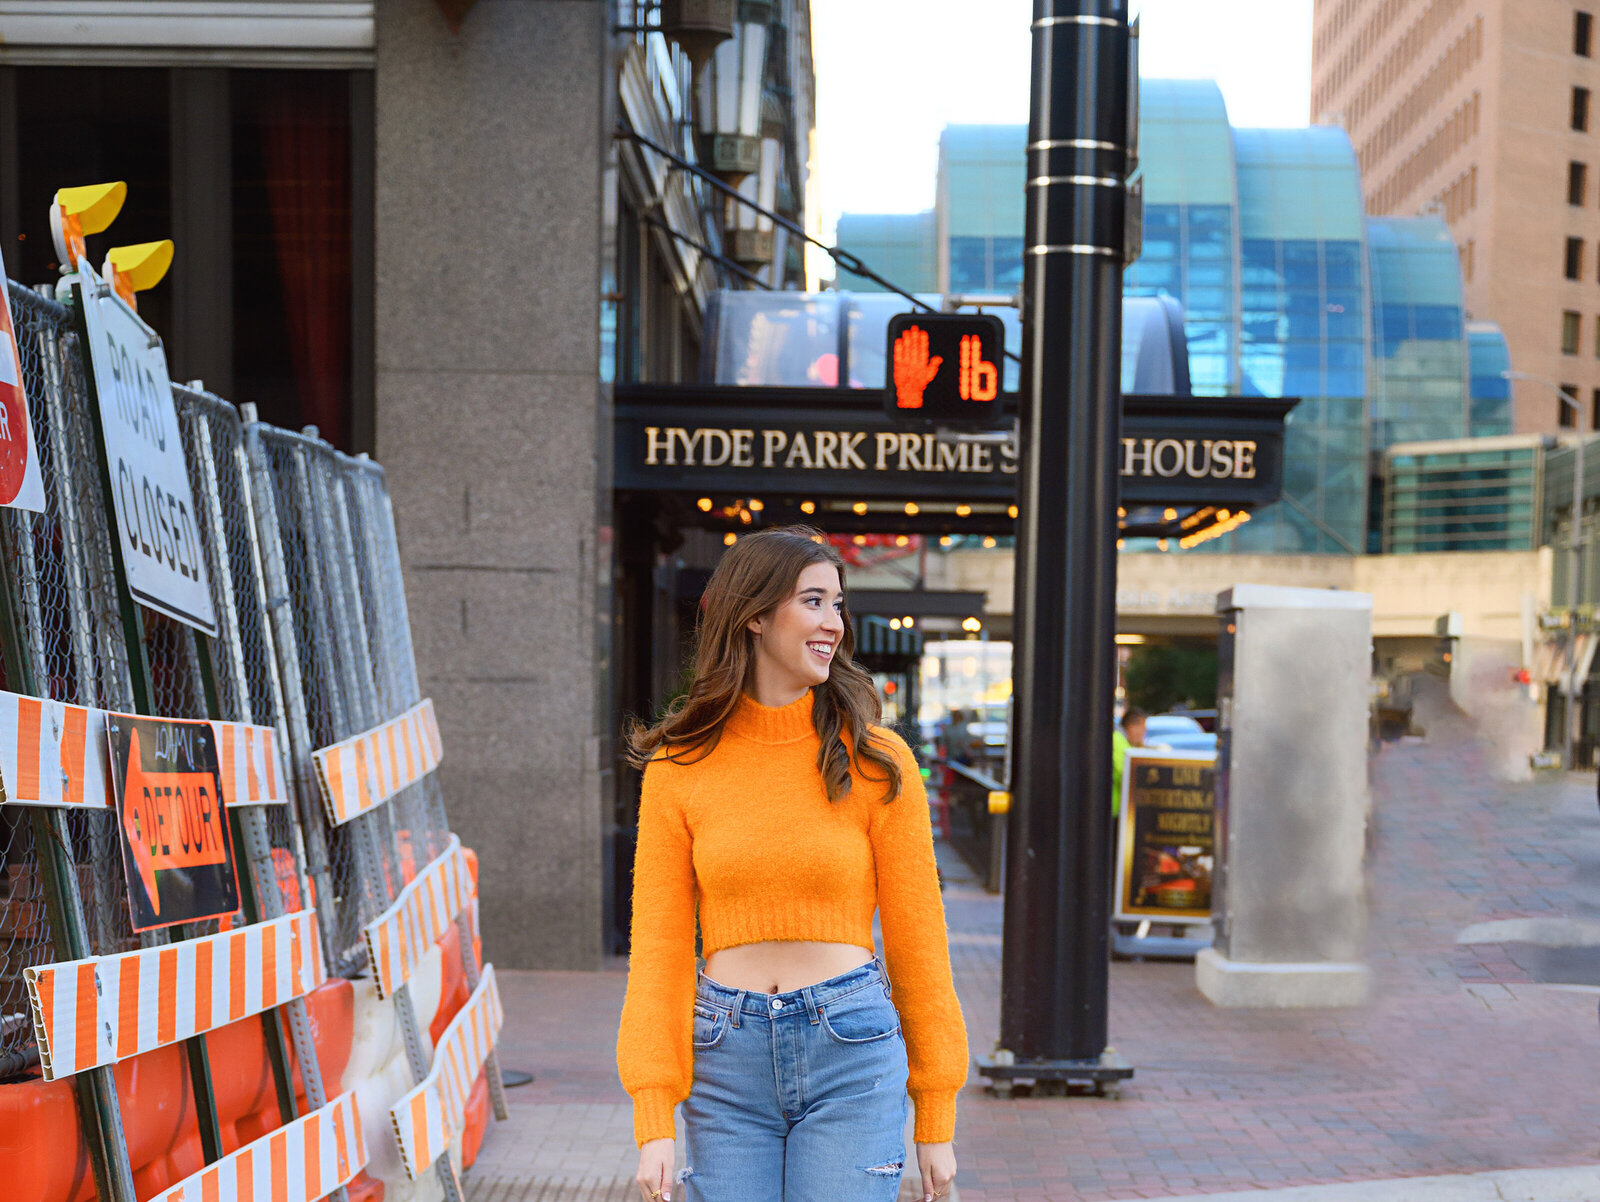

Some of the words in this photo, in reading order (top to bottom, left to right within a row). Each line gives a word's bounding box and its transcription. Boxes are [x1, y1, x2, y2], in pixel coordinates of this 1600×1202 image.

[106, 330, 166, 453] ROAD
[959, 334, 998, 402] 16
[644, 426, 755, 467] HYDE
[761, 430, 868, 470] PARK
[874, 432, 994, 473] PRIME
[118, 457, 199, 582] CLOSED
[143, 785, 218, 857] DETOUR
